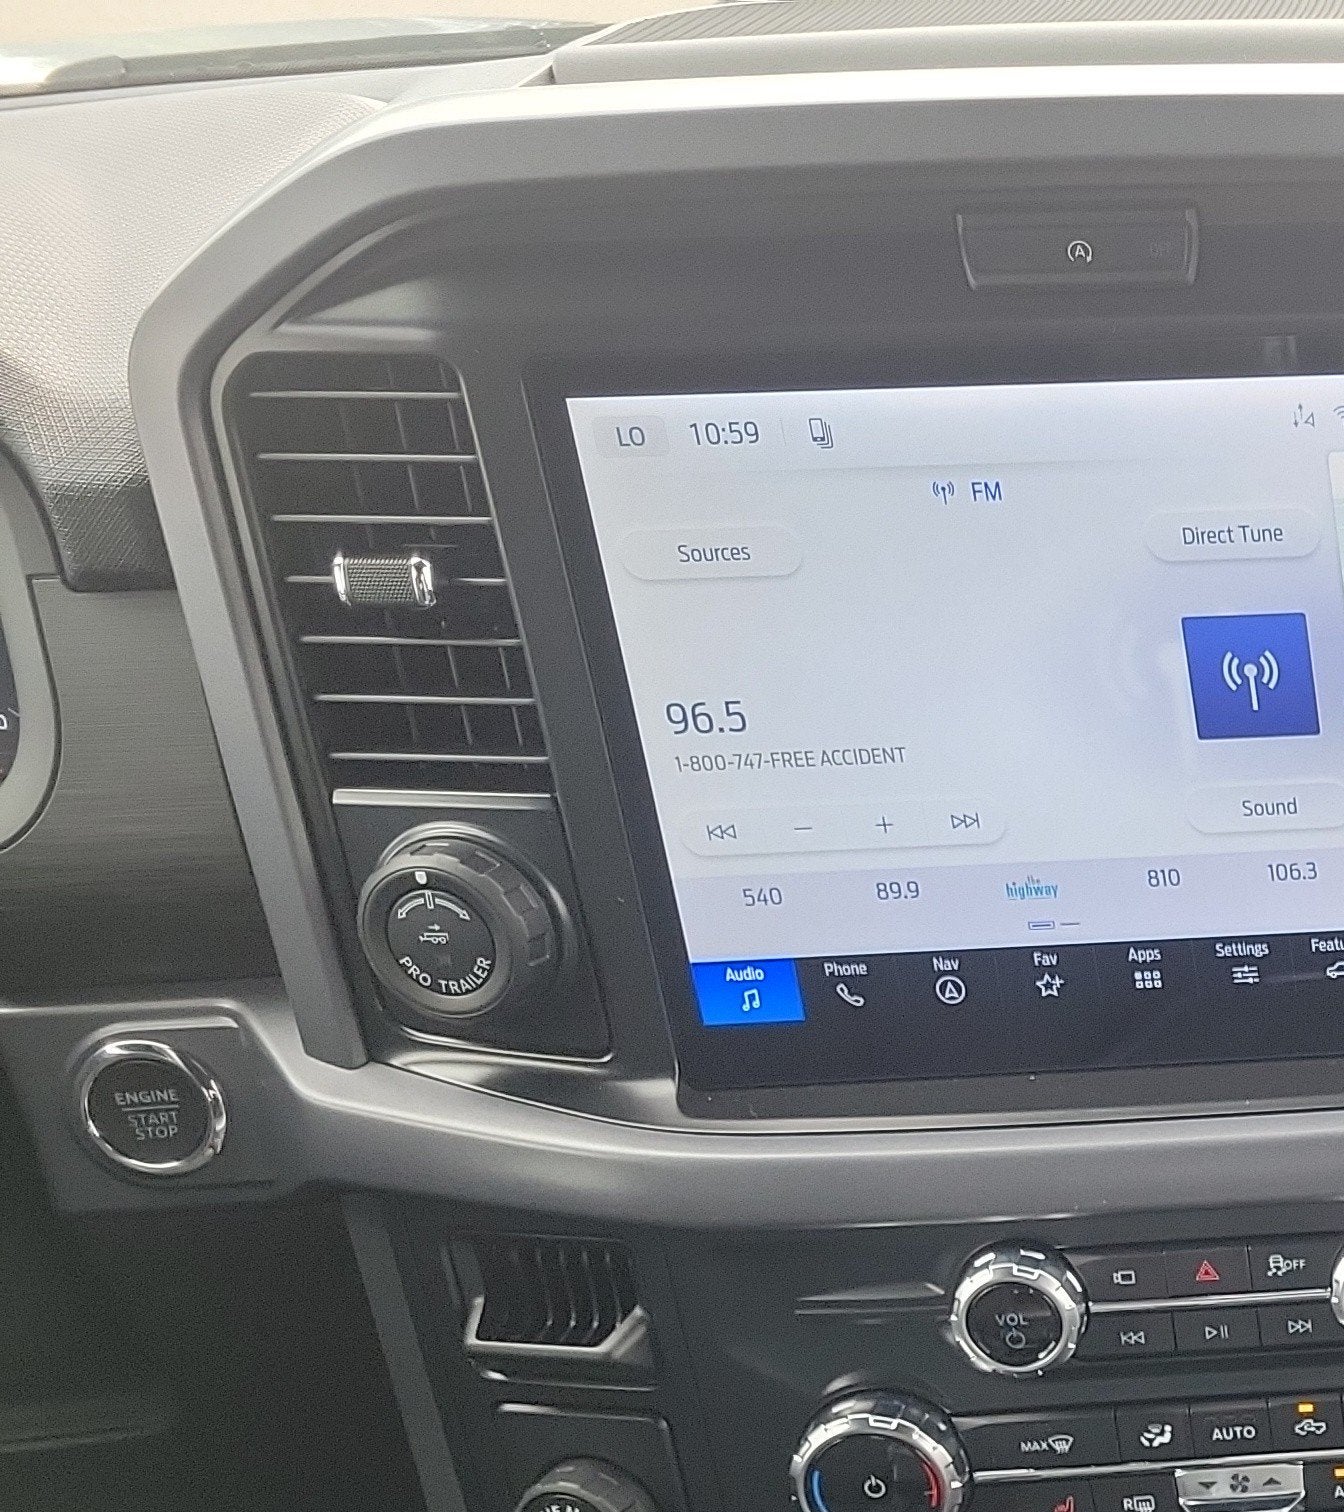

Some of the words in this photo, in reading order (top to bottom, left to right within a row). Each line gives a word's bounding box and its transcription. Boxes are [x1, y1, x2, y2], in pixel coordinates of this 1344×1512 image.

[616, 426, 646, 448] LO
[688, 420, 760, 447] 10:59
[971, 481, 1003, 502] FM
[1181, 524, 1236, 547] Direct
[1240, 523, 1284, 544] Tune
[677, 542, 751, 564] Sources
[666, 700, 748, 736] 96.5
[675, 748, 816, 774] 1-800-747-FREE
[820, 745, 906, 769] ACCIDENT
[1242, 797, 1298, 818] Sound
[1147, 868, 1181, 888] 810
[1268, 861, 1319, 883] 106.3
[742, 886, 783, 908] 540
[876, 879, 920, 901] 89.9
[1005, 881, 1058, 900] highway
[1033, 950, 1058, 967] Fav
[1128, 947, 1161, 965] Apps
[1215, 940, 1270, 962] Settings
[824, 960, 868, 977] Phone
[932, 955, 959, 972] Nav
[398, 955, 433, 990] PRO
[438, 956, 492, 997] TRAILER
[725, 965, 765, 983] Audio
[114, 1088, 179, 1106] ENGINE
[127, 1110, 179, 1127] START
[134, 1125, 179, 1141] STOP
[1284, 1257, 1306, 1271] OFF
[995, 1313, 1029, 1327] VOL
[1212, 1426, 1256, 1442] AUTO
[1020, 1439, 1049, 1454] MAX
